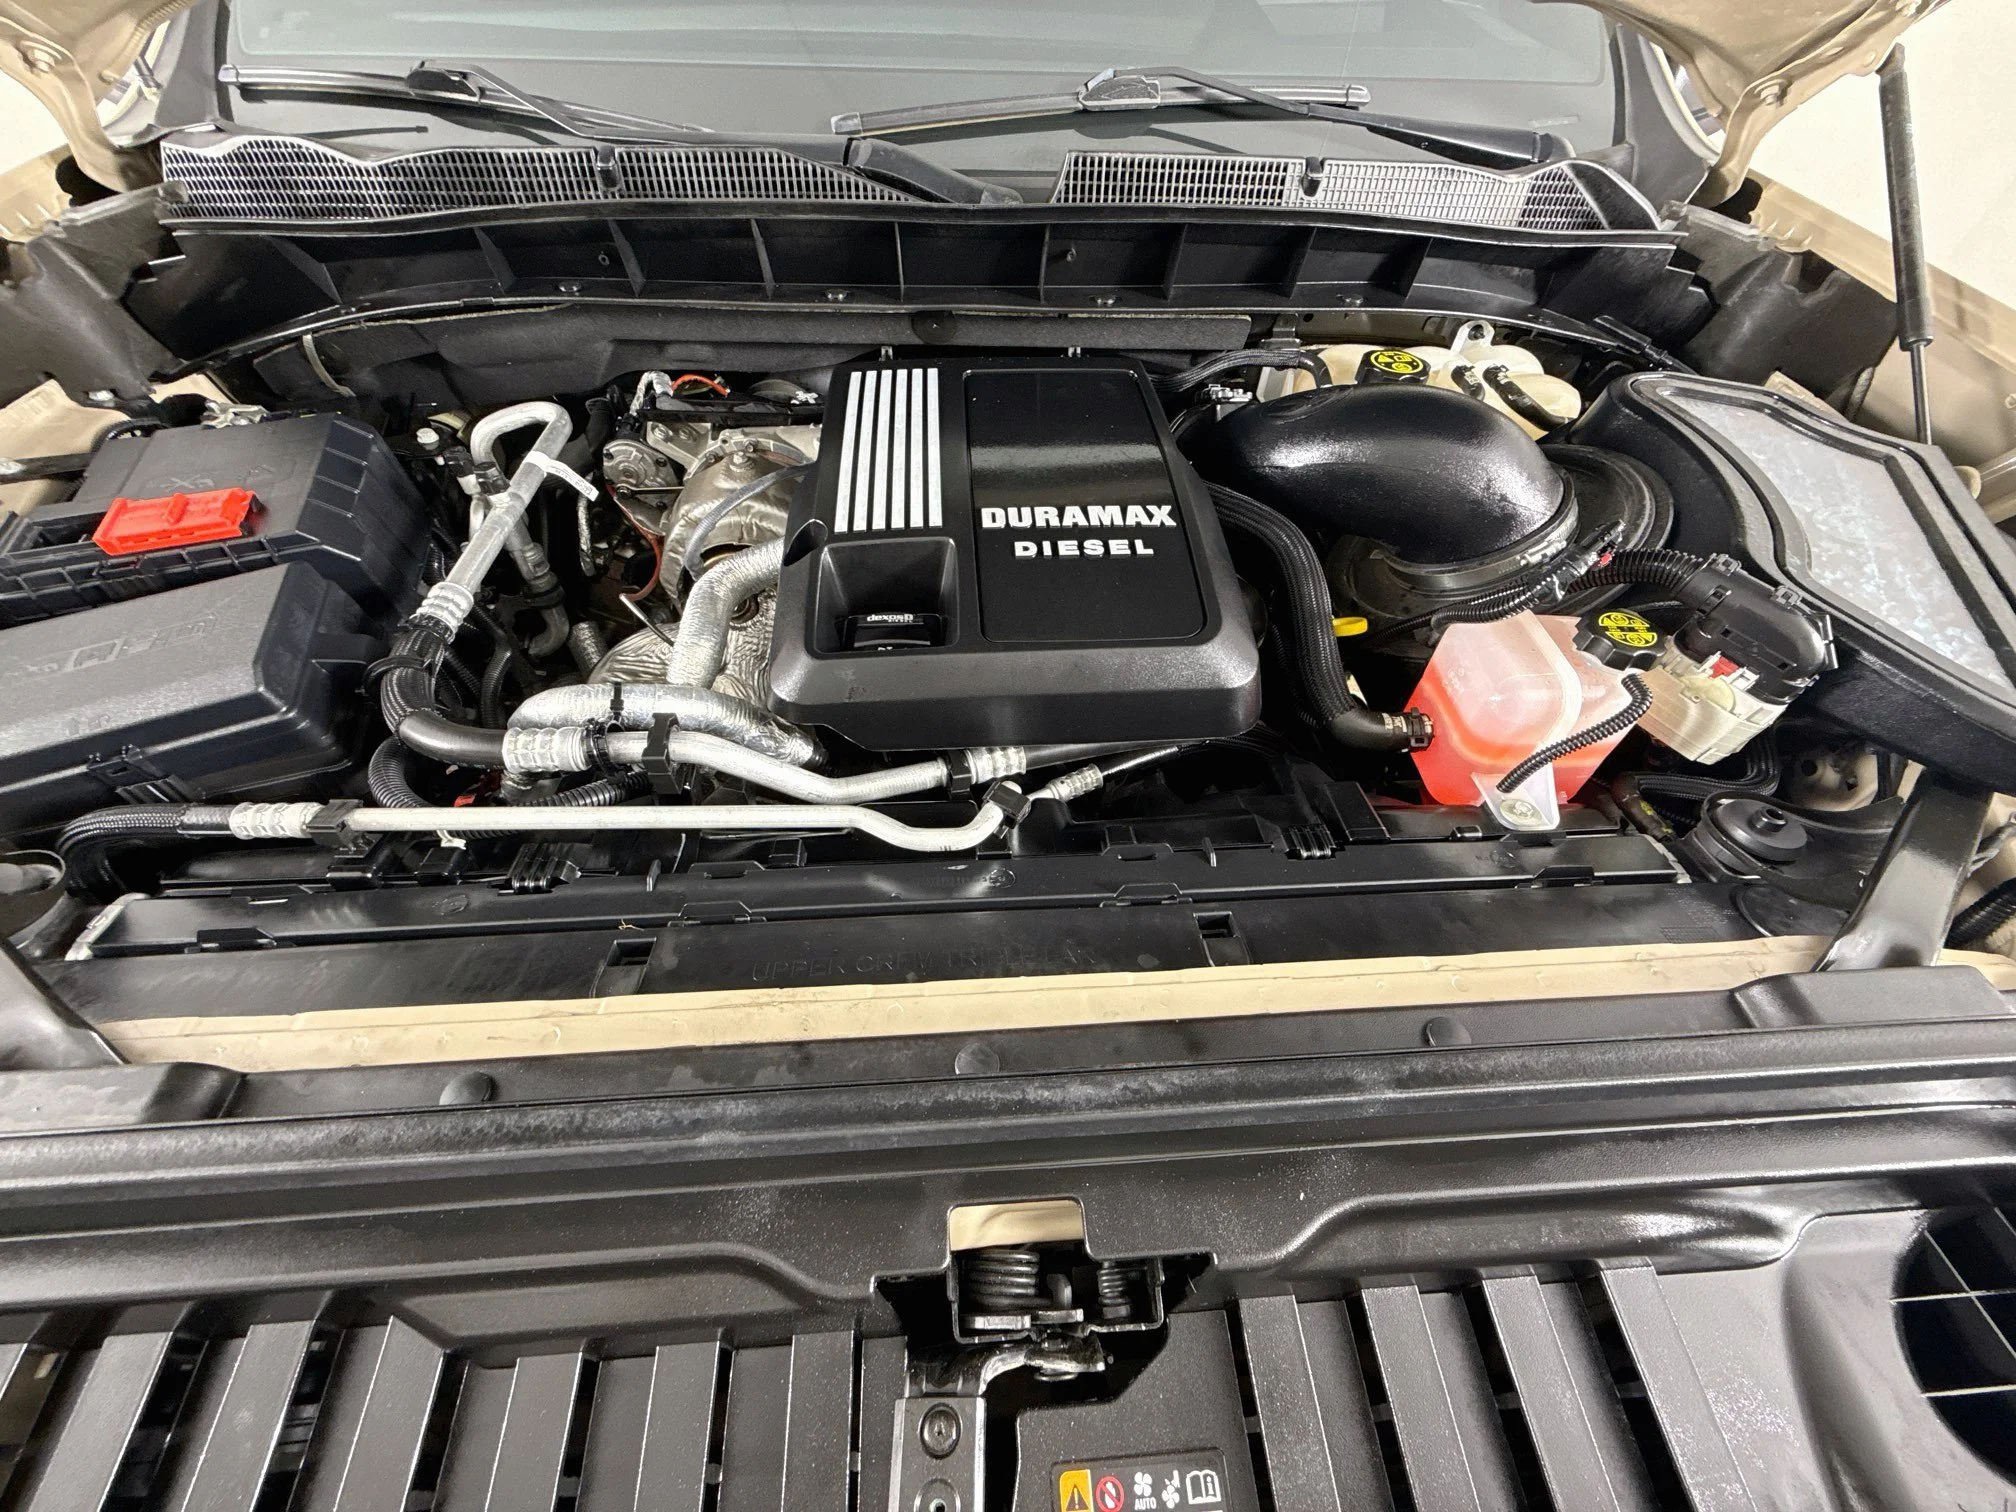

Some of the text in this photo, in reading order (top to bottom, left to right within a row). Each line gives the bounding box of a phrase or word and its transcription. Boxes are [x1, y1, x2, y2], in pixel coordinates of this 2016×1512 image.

[981, 505, 1177, 529] DURAMAX
[1014, 539, 1154, 558] DIESEL
[752, 956, 847, 982] UPPER
[1134, 1497, 1157, 1511] AUTO
